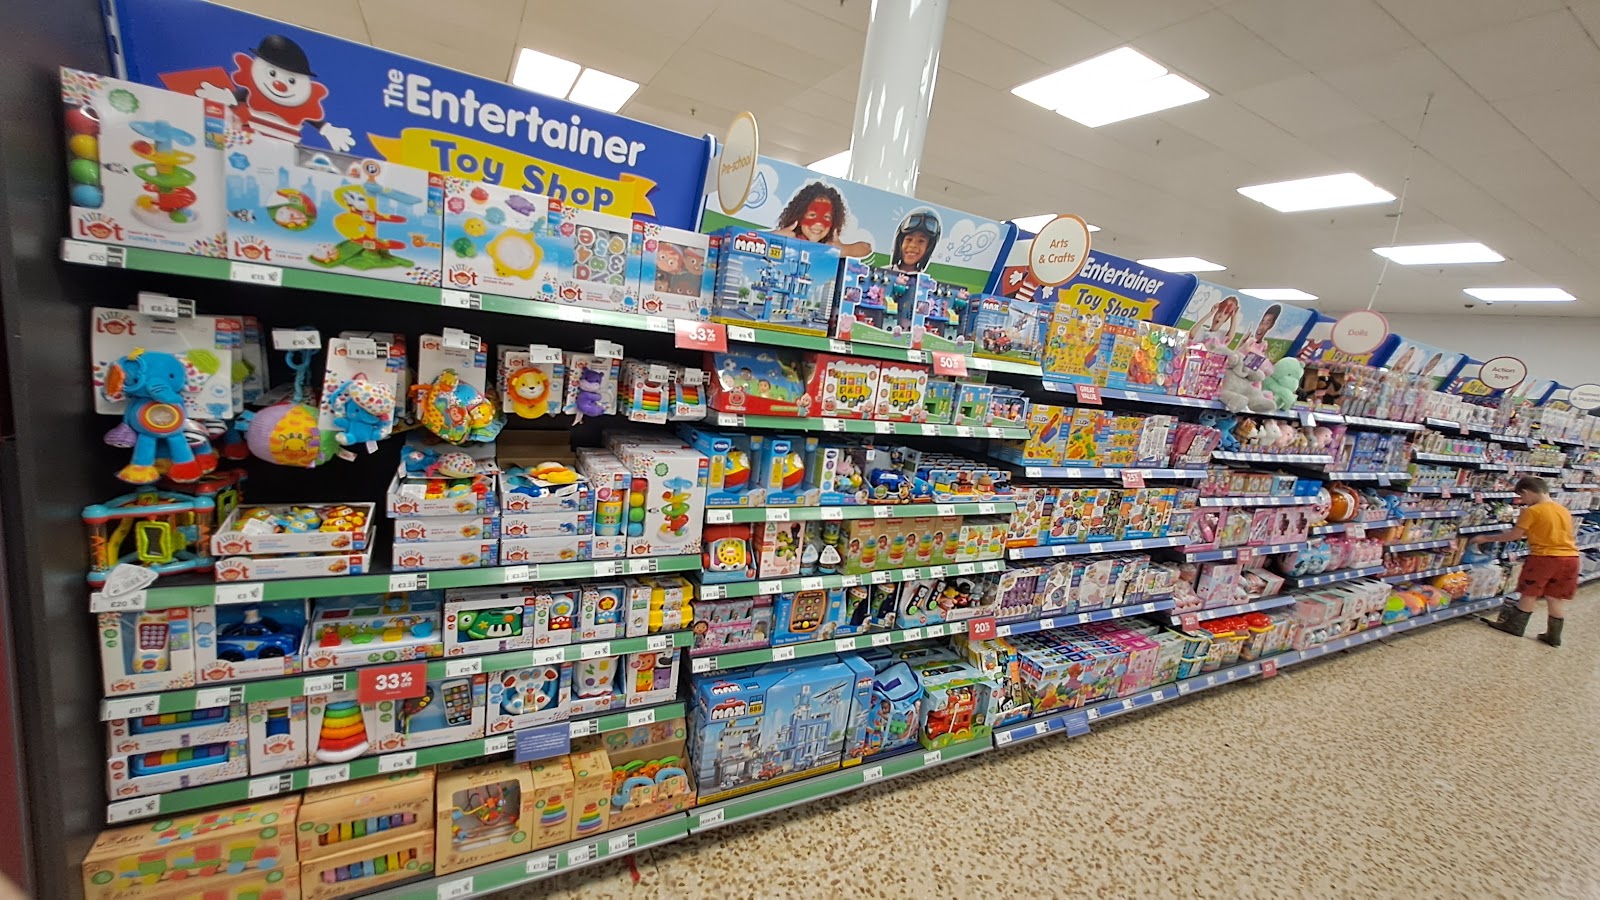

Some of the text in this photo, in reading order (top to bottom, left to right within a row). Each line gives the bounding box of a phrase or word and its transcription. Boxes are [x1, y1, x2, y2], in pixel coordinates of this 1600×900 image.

[383, 68, 404, 108] The
[406, 73, 646, 167] Entertainer
[721, 155, 752, 176] Pre-school
[430, 139, 614, 212] Toy Shop
[735, 238, 782, 259] MAX 321
[1049, 238, 1068, 249] Arts
[1038, 252, 1075, 264] & Crafts
[1079, 257, 1164, 294] Entertainer
[1077, 289, 1139, 318] Toy Shop
[688, 327, 716, 341] 33%
[1347, 329, 1369, 337] Dolls
[1492, 366, 1515, 374] Action
[1079, 385, 1096, 395] GREAT
[1080, 391, 1098, 400] VALUE
[376, 672, 412, 691] 33%
[712, 702, 745, 719] MAX
